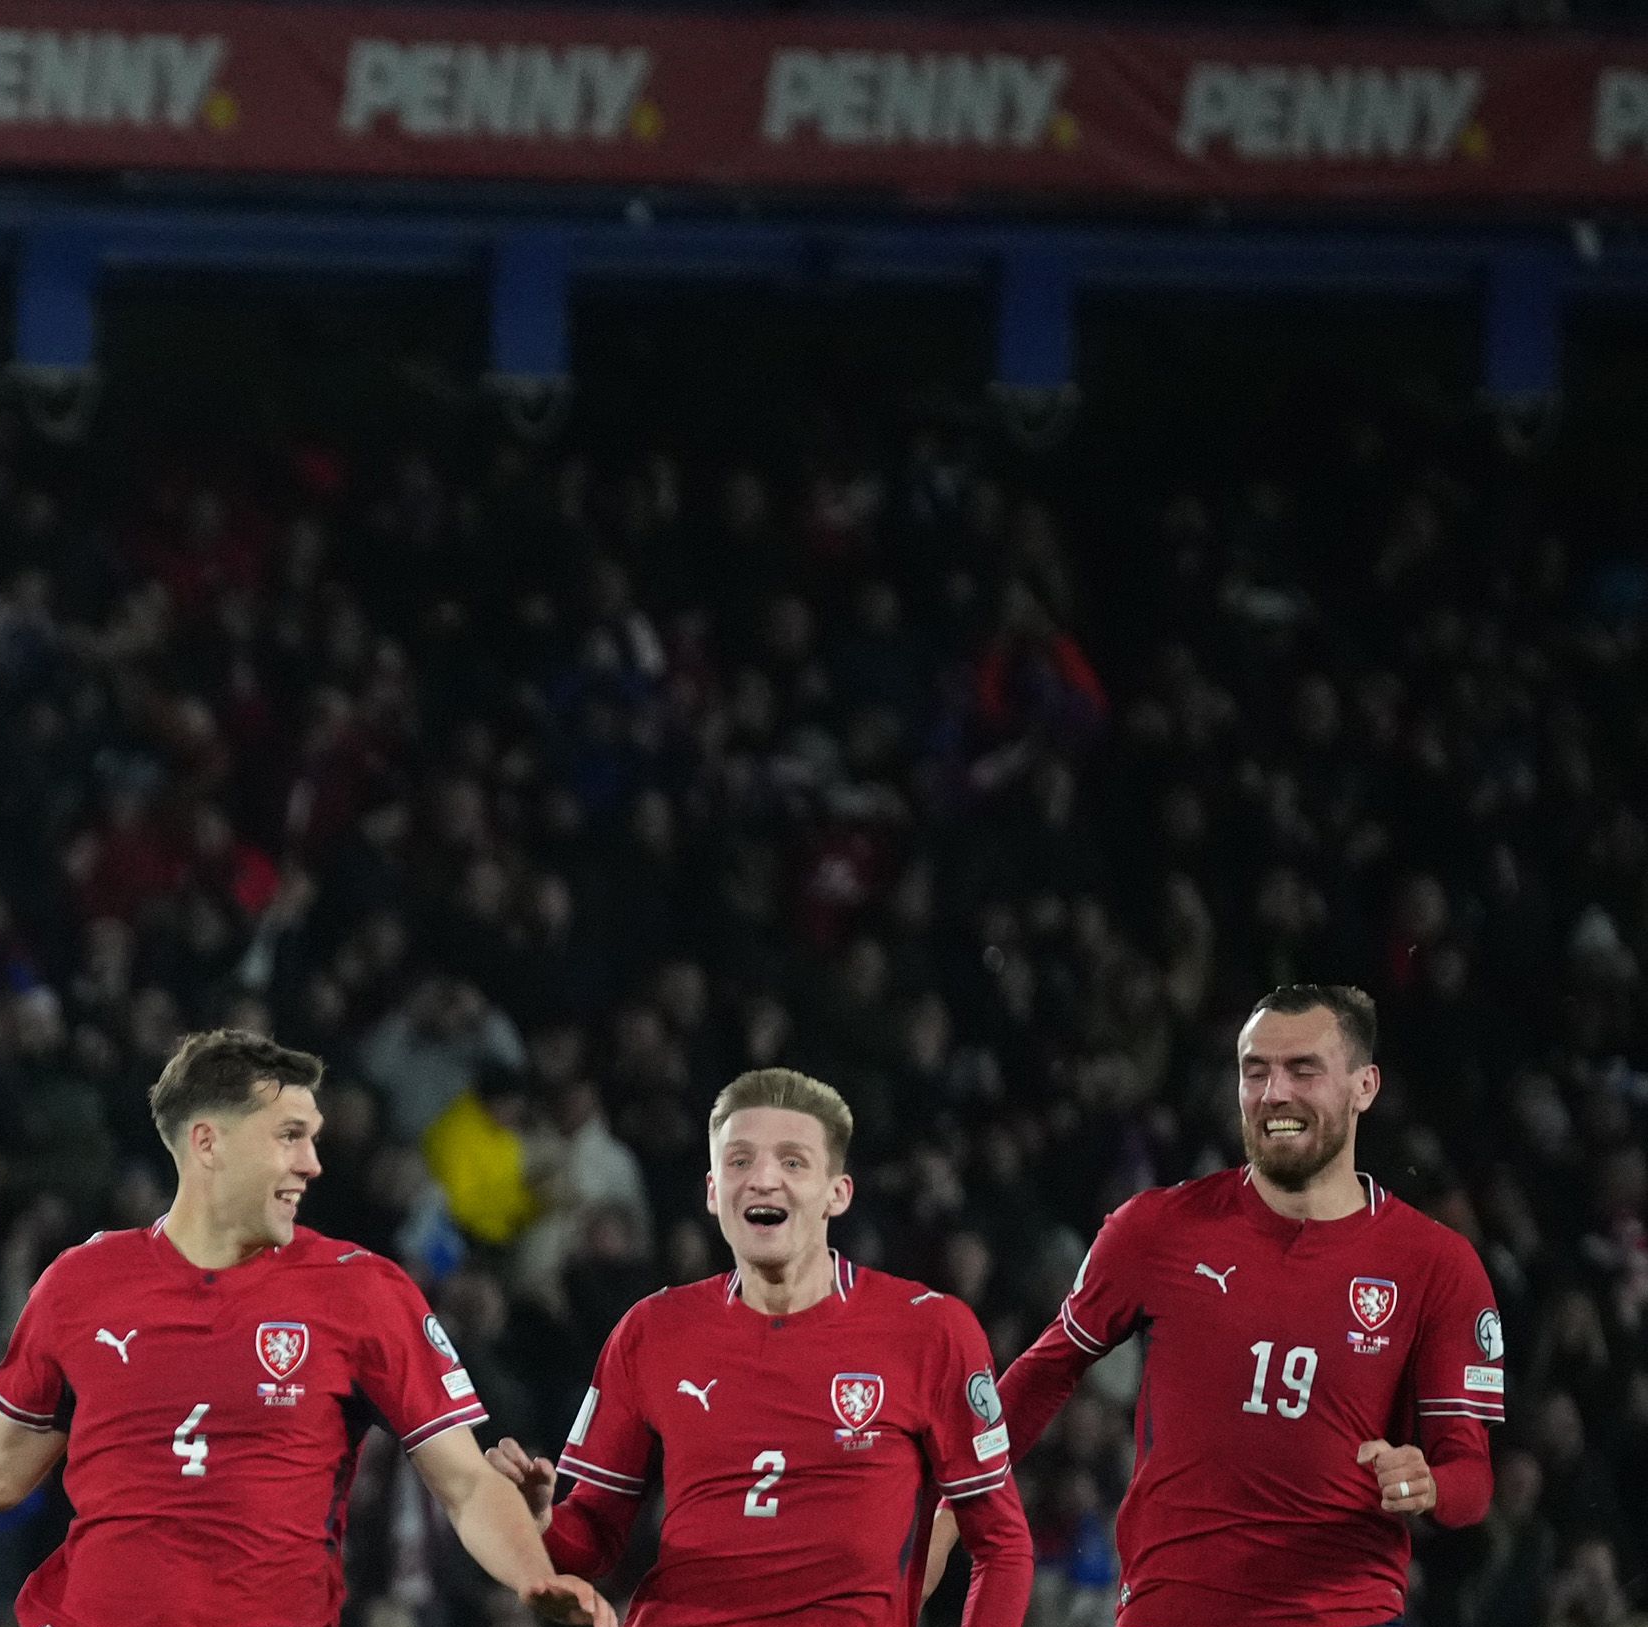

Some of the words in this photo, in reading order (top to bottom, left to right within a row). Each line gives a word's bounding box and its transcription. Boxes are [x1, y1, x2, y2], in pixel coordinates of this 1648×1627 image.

[1242, 1340, 1319, 1420] 19
[171, 1403, 211, 1478] 4
[743, 1450, 787, 1518] 2
